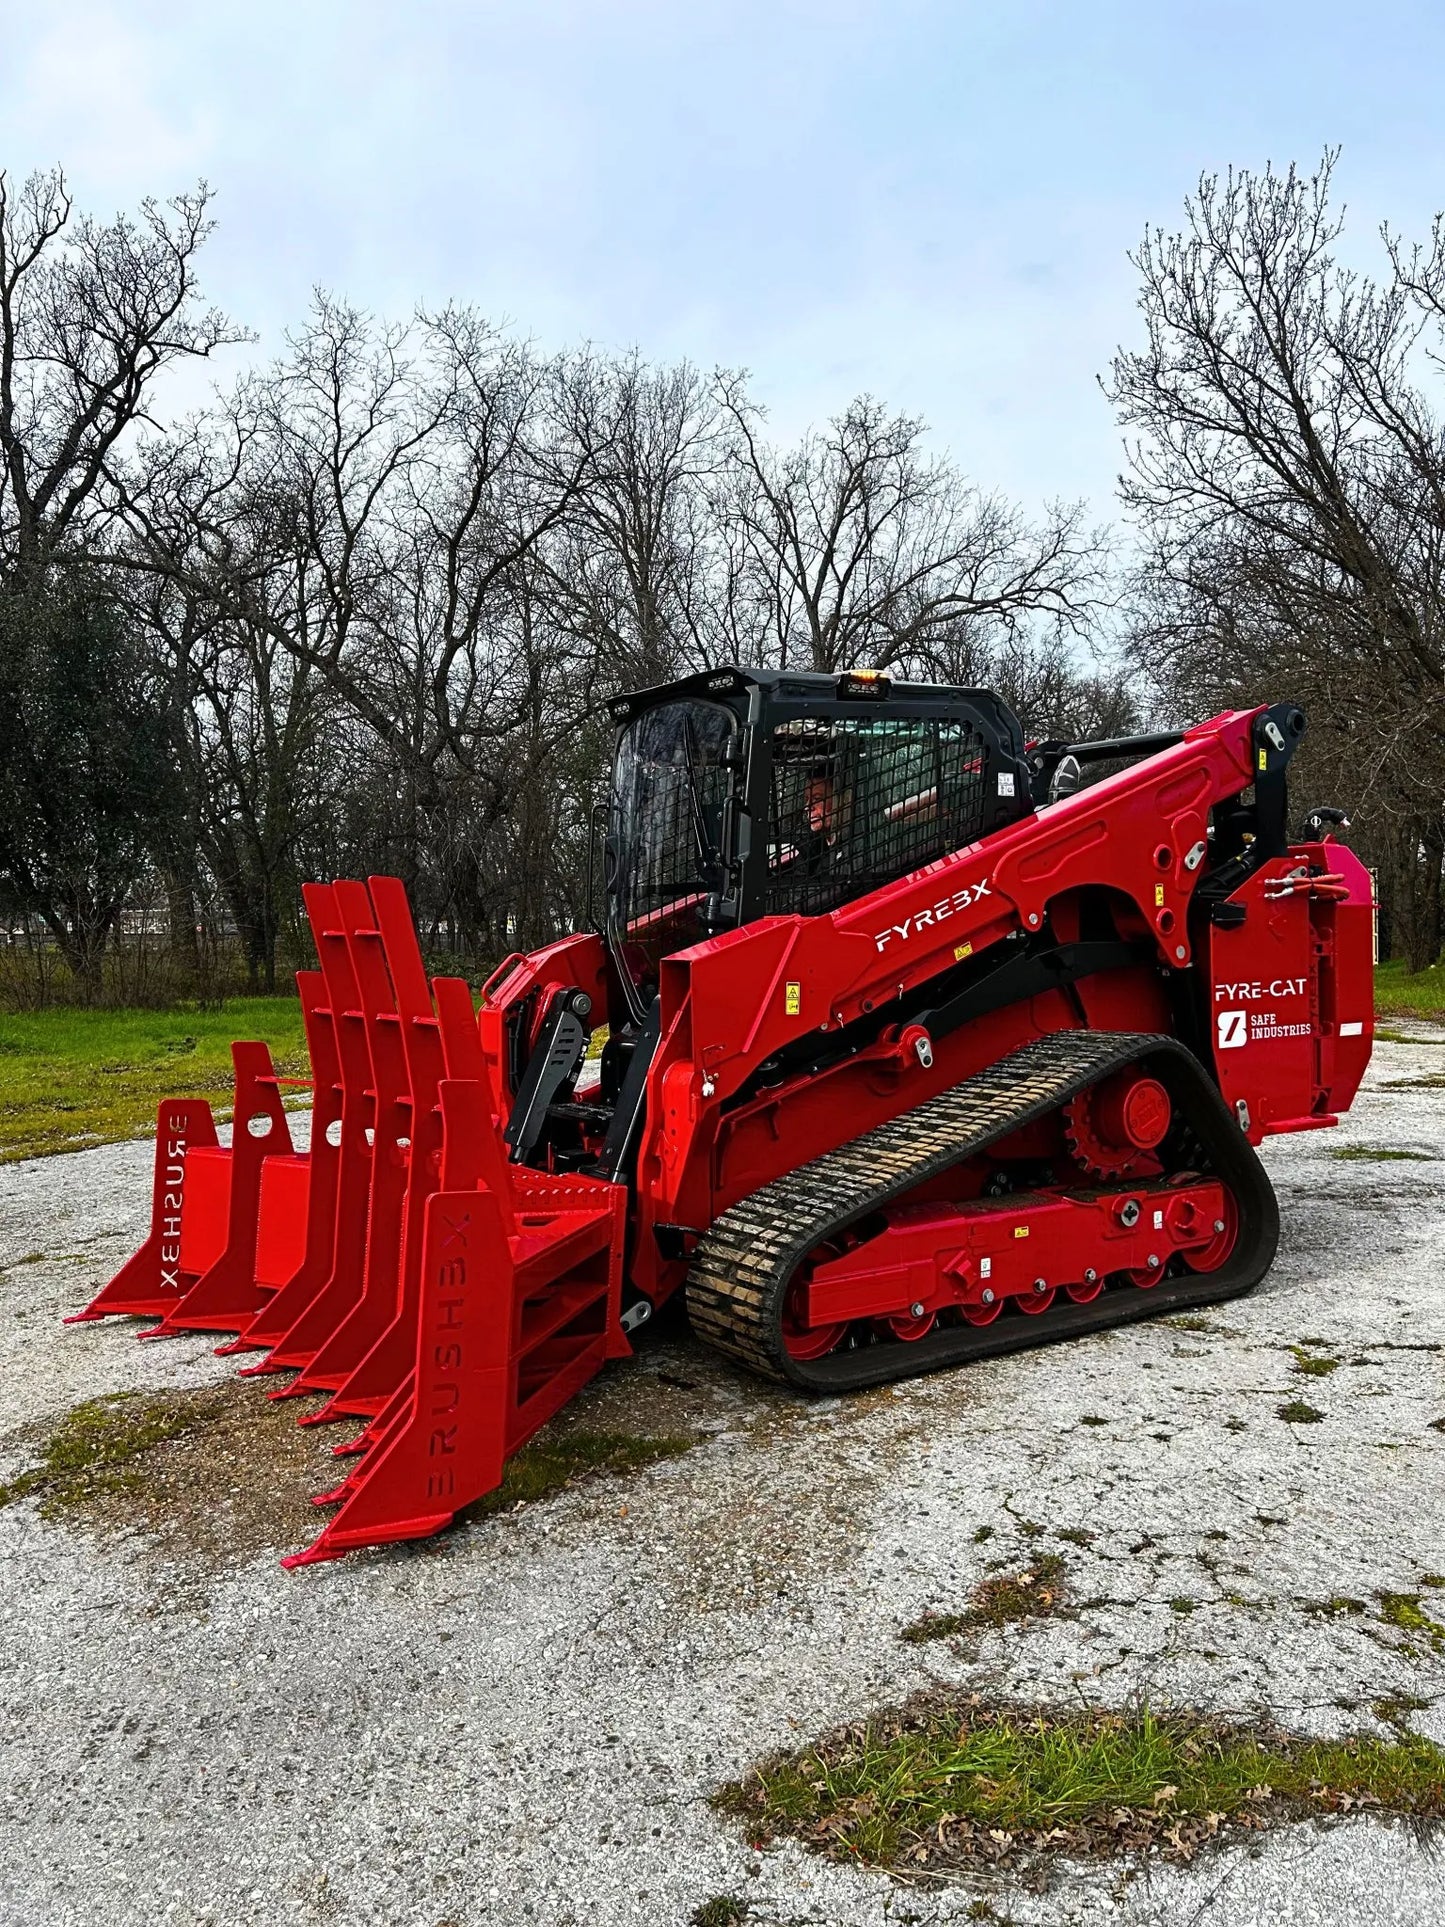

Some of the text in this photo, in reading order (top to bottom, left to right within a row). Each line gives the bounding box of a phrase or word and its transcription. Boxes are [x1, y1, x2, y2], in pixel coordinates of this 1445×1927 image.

[1215, 979, 1307, 1001] FYRE-CAT
[1251, 1013, 1276, 1026] SAFE
[1251, 1024, 1311, 1039] INDUSTRIES
